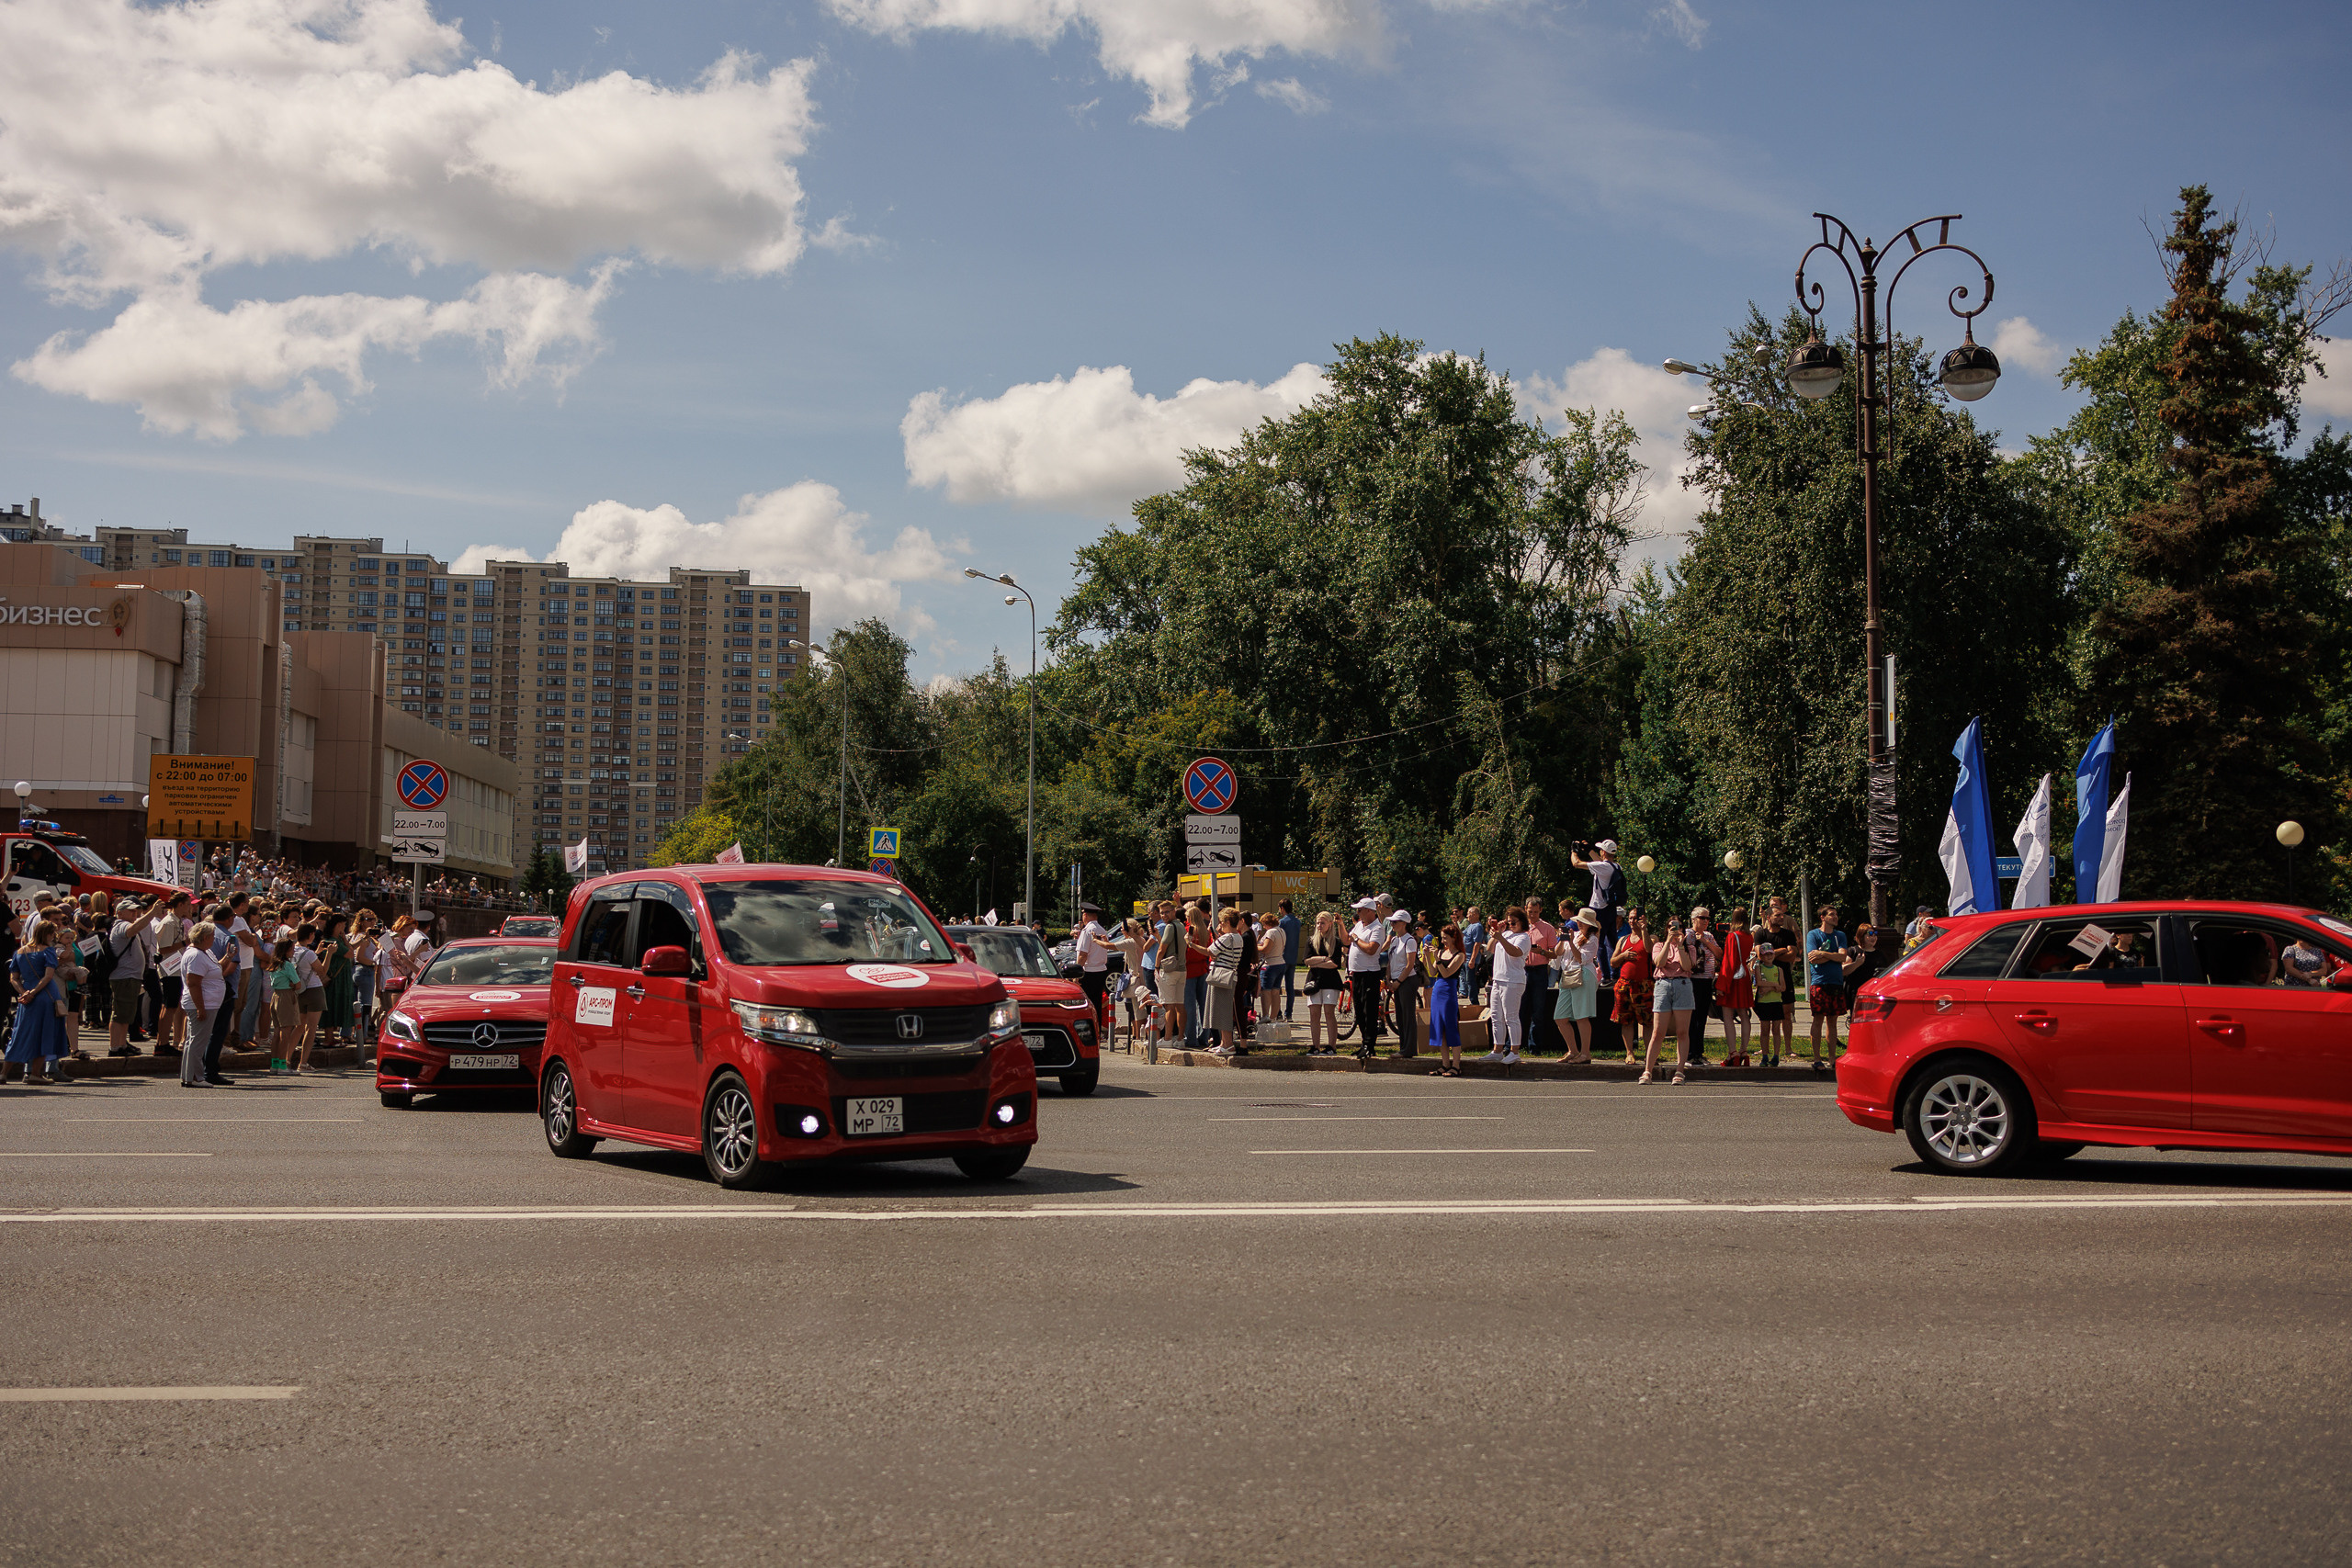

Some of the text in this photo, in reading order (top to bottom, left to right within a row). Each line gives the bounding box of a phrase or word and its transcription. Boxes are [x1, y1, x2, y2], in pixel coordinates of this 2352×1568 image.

[170, 759, 235, 770] Внимание!
[166, 771, 197, 780] 22:00
[198, 773, 214, 783] до
[217, 773, 247, 782] 07:00
[1284, 876, 1306, 888] WC
[588, 997, 614, 1010] АРС-ПРОМ
[1031, 1036, 1041, 1044] 72
[454, 1055, 515, 1067] Р 479 НР 72
[855, 1099, 895, 1115] Х 029
[853, 1115, 899, 1134] МР 72
